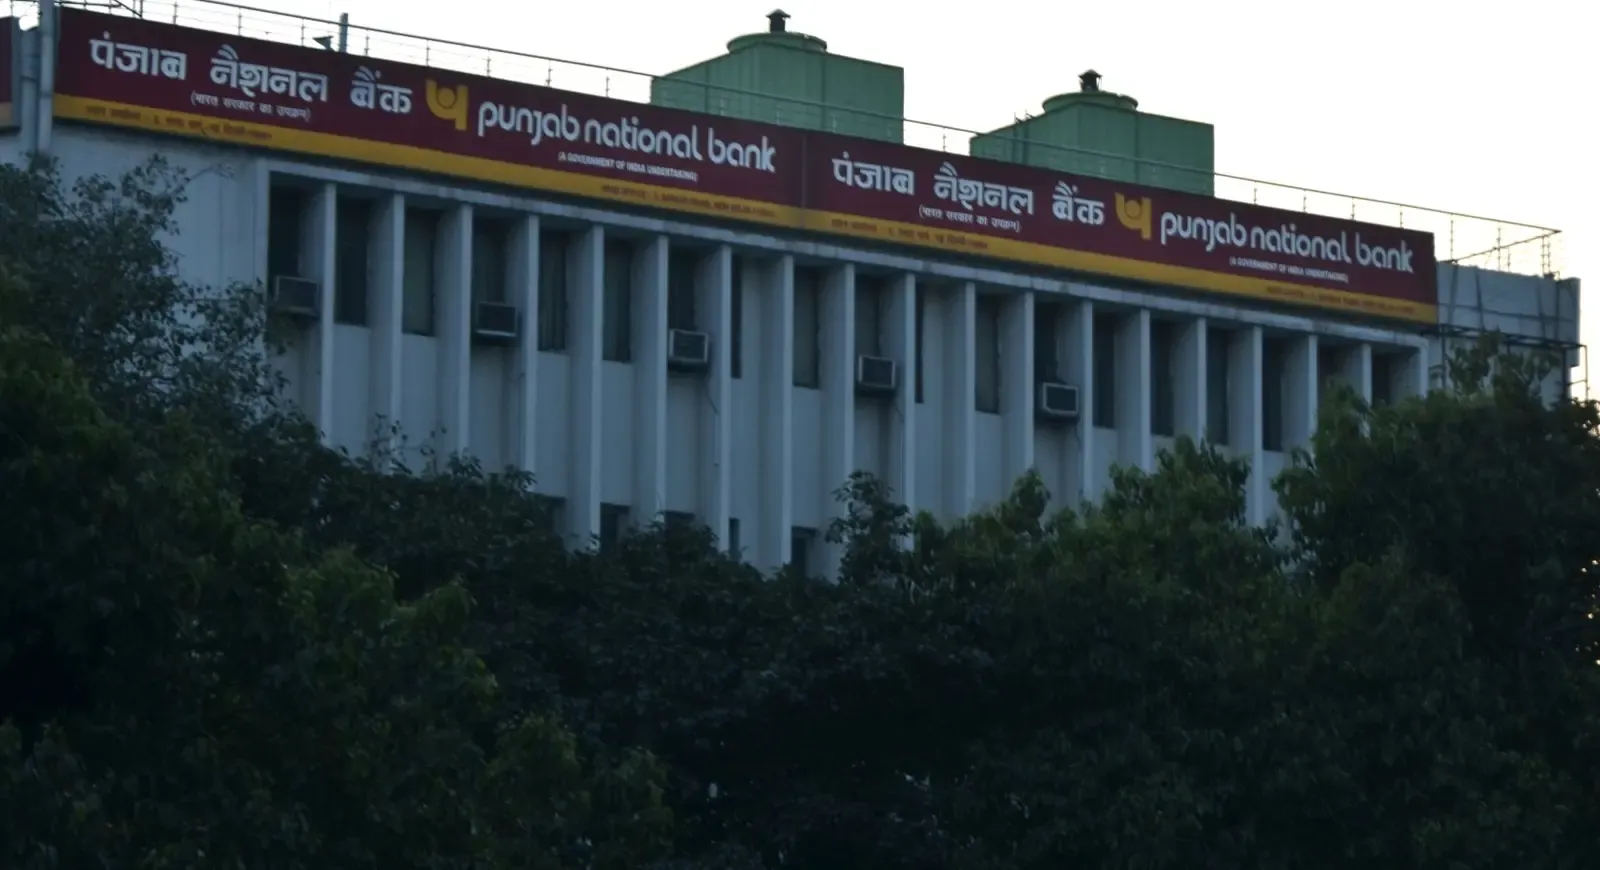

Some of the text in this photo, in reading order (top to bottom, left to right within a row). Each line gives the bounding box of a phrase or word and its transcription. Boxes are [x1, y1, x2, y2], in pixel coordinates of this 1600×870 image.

[89, 31, 413, 114] पंजाब नैशनल बैंक
[478, 101, 776, 173] punjab national bank
[567, 152, 616, 168] GOVERNMENT
[616, 160, 626, 170] OF
[627, 161, 646, 174] INDIA
[831, 151, 1105, 225] पंजाब नैशनल बैंक
[1160, 211, 1414, 274] punjab national bank
